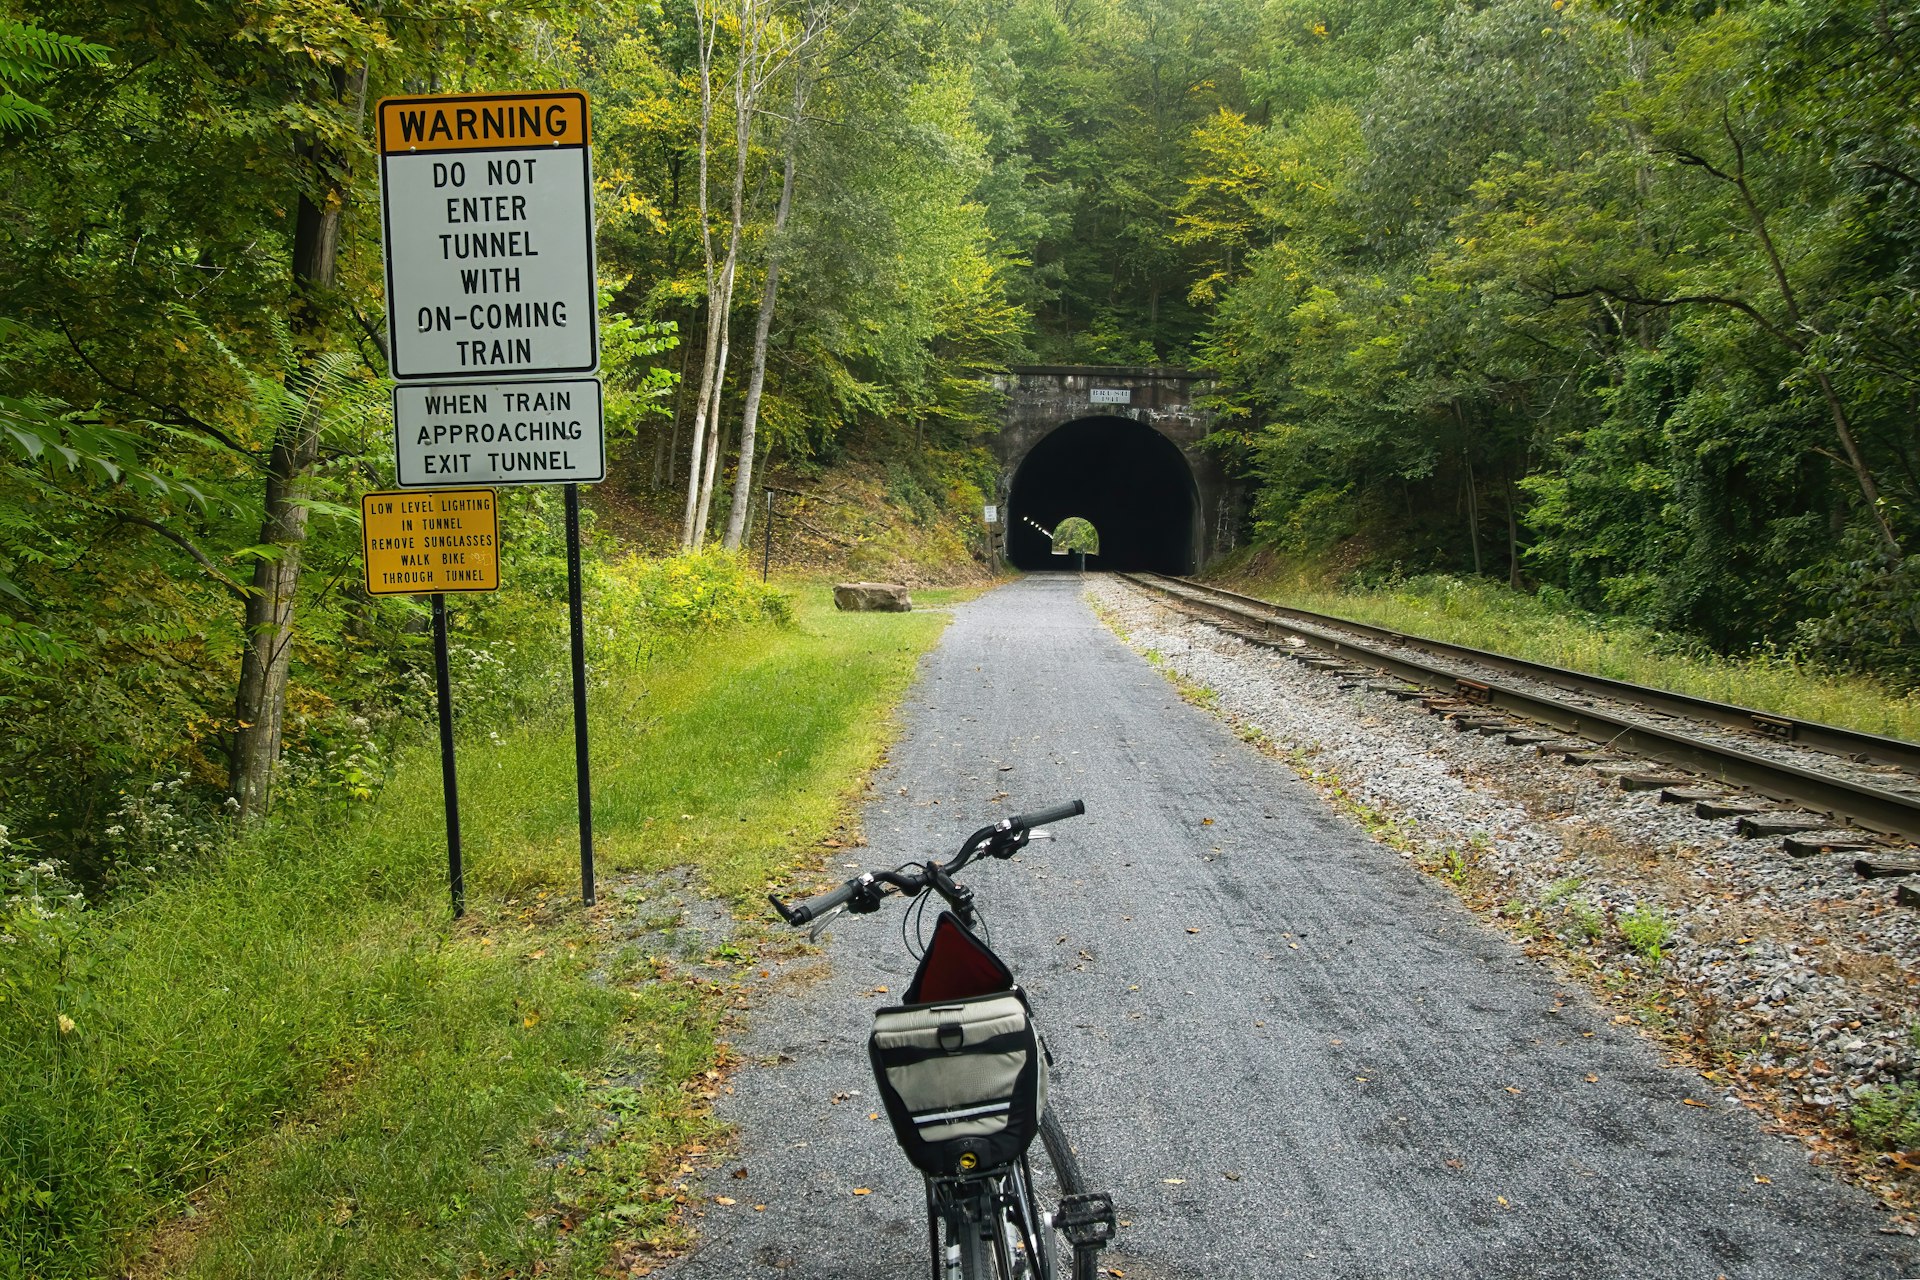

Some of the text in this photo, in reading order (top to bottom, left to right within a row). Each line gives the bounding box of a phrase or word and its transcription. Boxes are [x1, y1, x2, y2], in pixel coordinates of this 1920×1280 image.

[400, 105, 567, 142] WARNING
[433, 159, 536, 187] DO NOT
[447, 196, 526, 223] ENTER
[439, 231, 538, 259] TUNNEL
[461, 268, 520, 294] WITH
[418, 302, 566, 332] ON-COMING
[457, 339, 530, 365] TRAIN
[425, 392, 570, 414] WHEN TRAIN
[417, 421, 581, 445] APPROACHING
[425, 451, 575, 473] EXIT TUNNEL
[371, 499, 489, 514] LOW LEVEL LIGHTING
[402, 518, 462, 531] IN TUNNEL
[372, 535, 491, 550] REMOVE SUNGLASSES
[401, 554, 429, 565] WALK
[443, 553, 464, 564] BIKE
[383, 570, 484, 584] THROUGH TUNNEL
